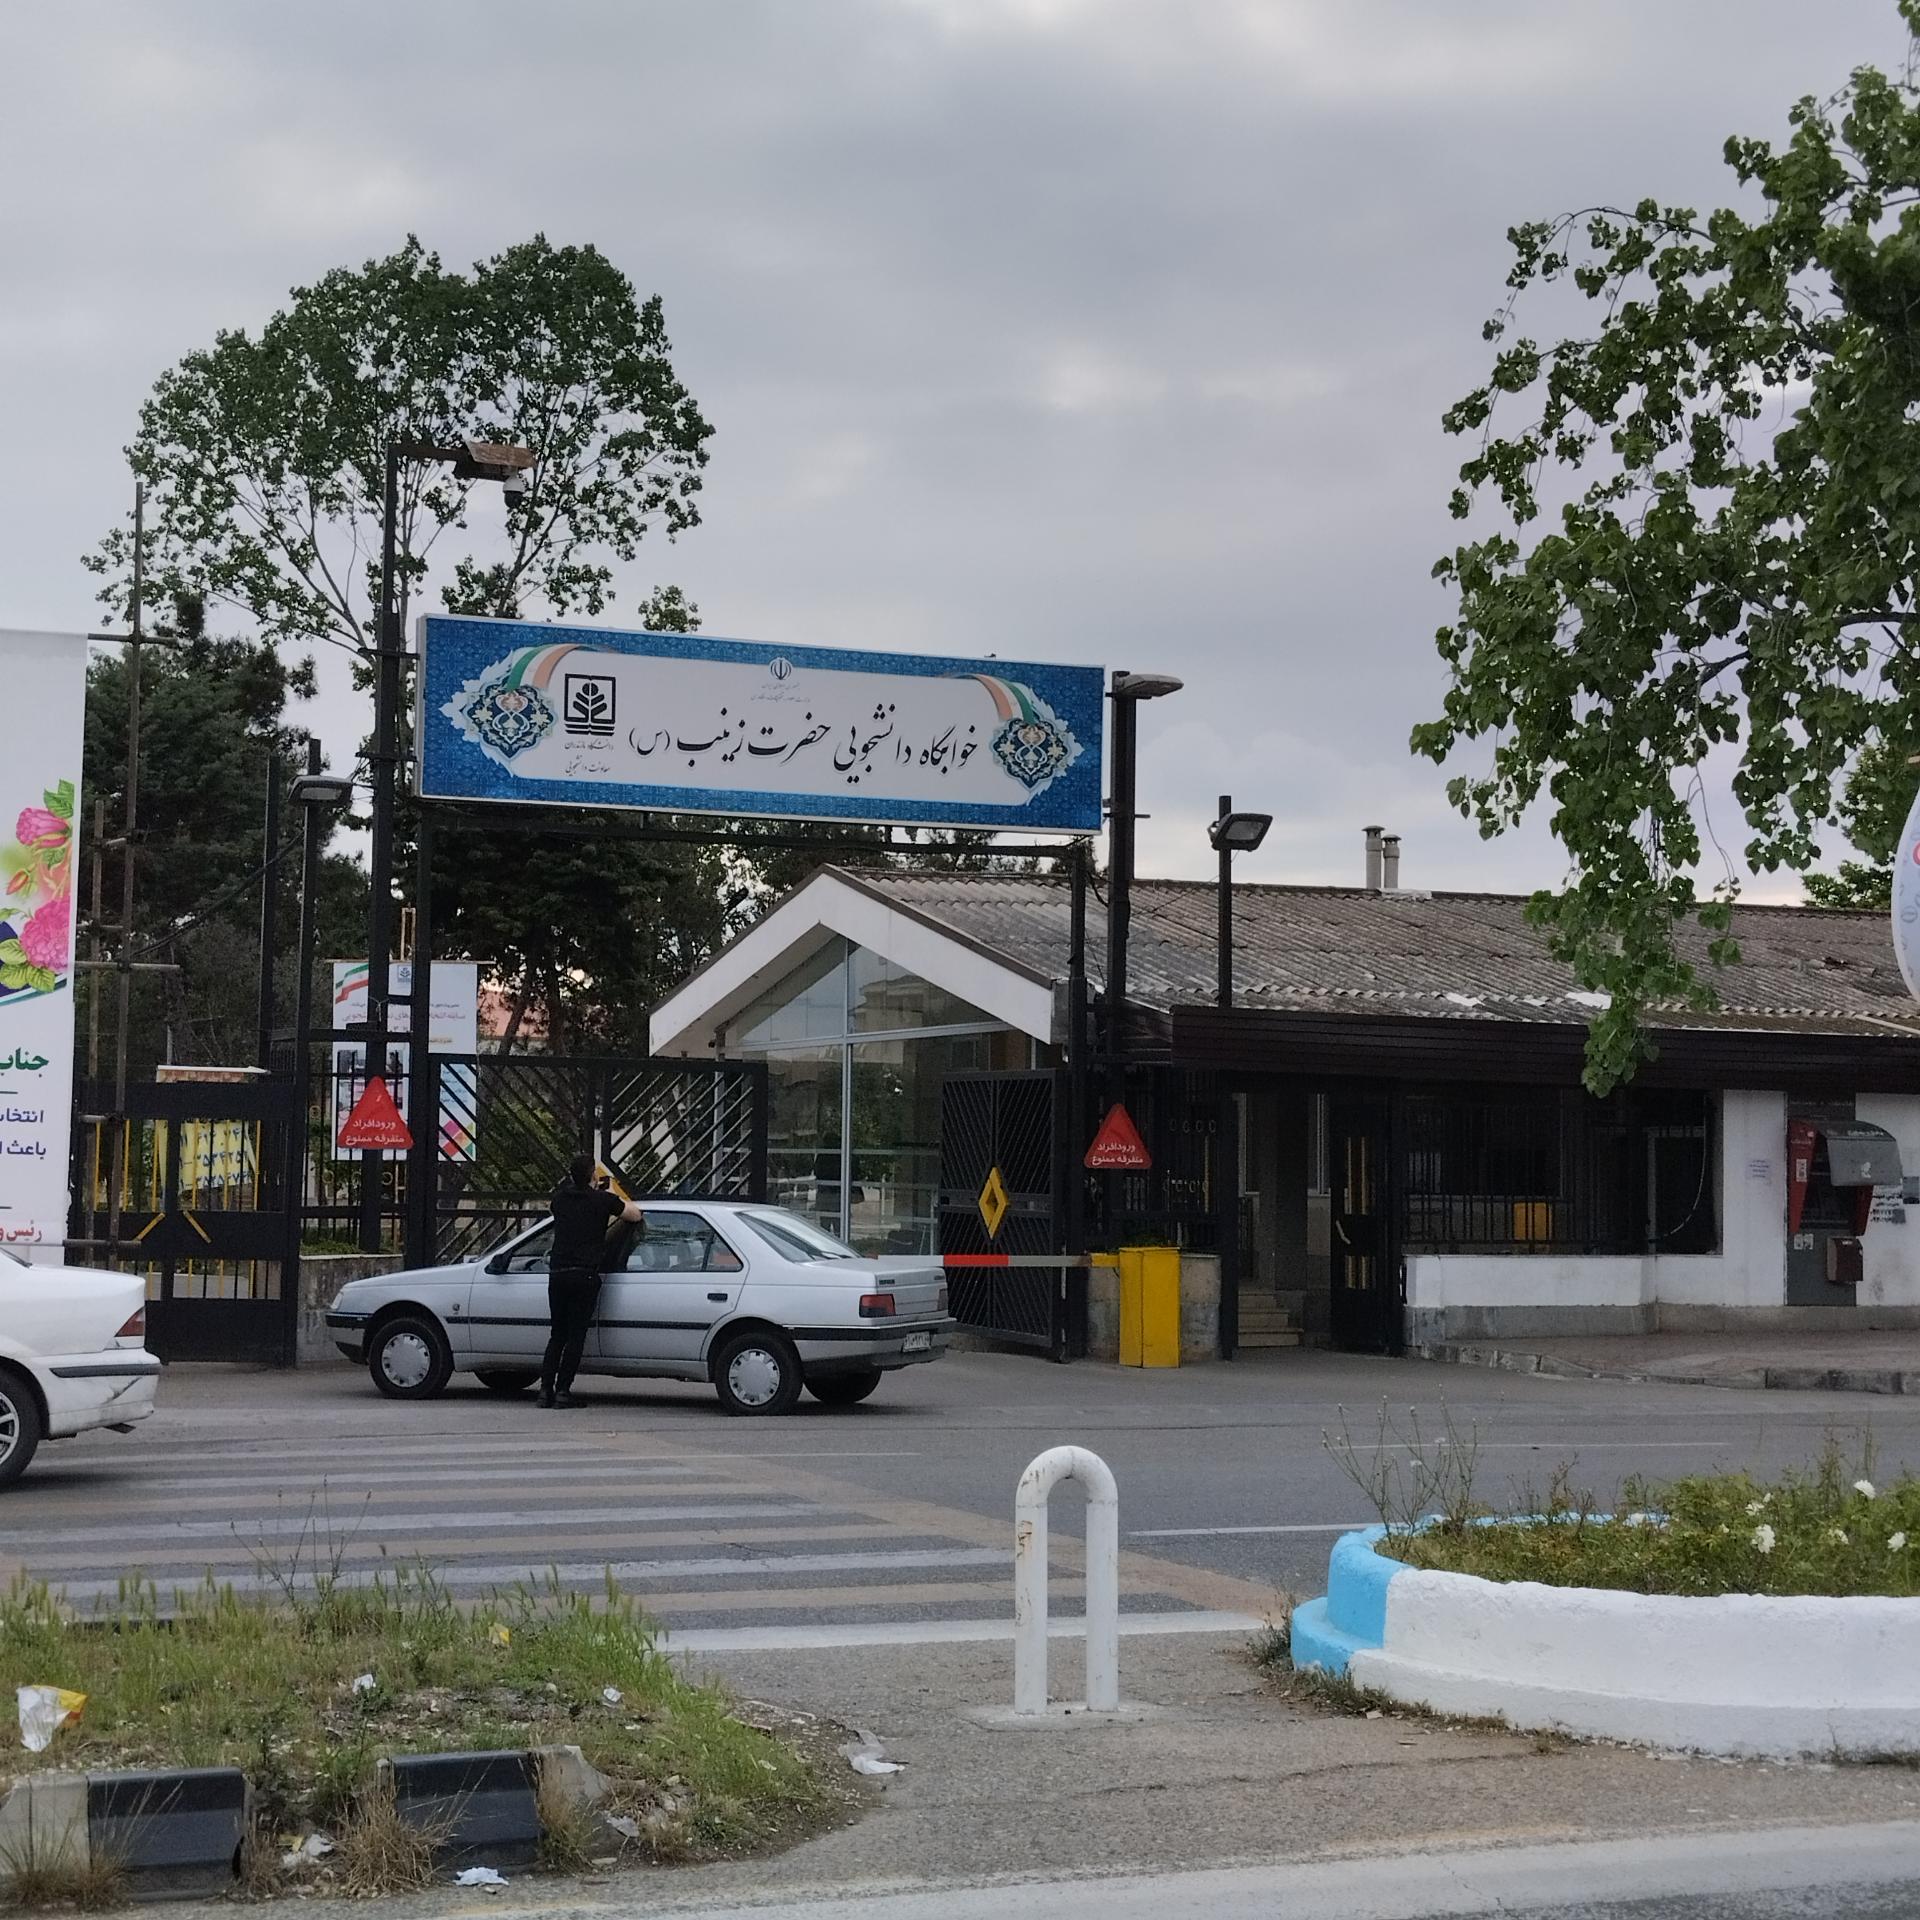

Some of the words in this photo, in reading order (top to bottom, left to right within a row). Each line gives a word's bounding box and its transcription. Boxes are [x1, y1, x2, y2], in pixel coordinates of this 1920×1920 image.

[628, 727, 671, 756] (س)
[676, 707, 746, 768] زینب
[747, 711, 832, 765] حضرت
[833, 703, 912, 784] دانشجویی
[920, 725, 978, 774] خوابگاه
[7, 1139, 47, 1160] باعث
